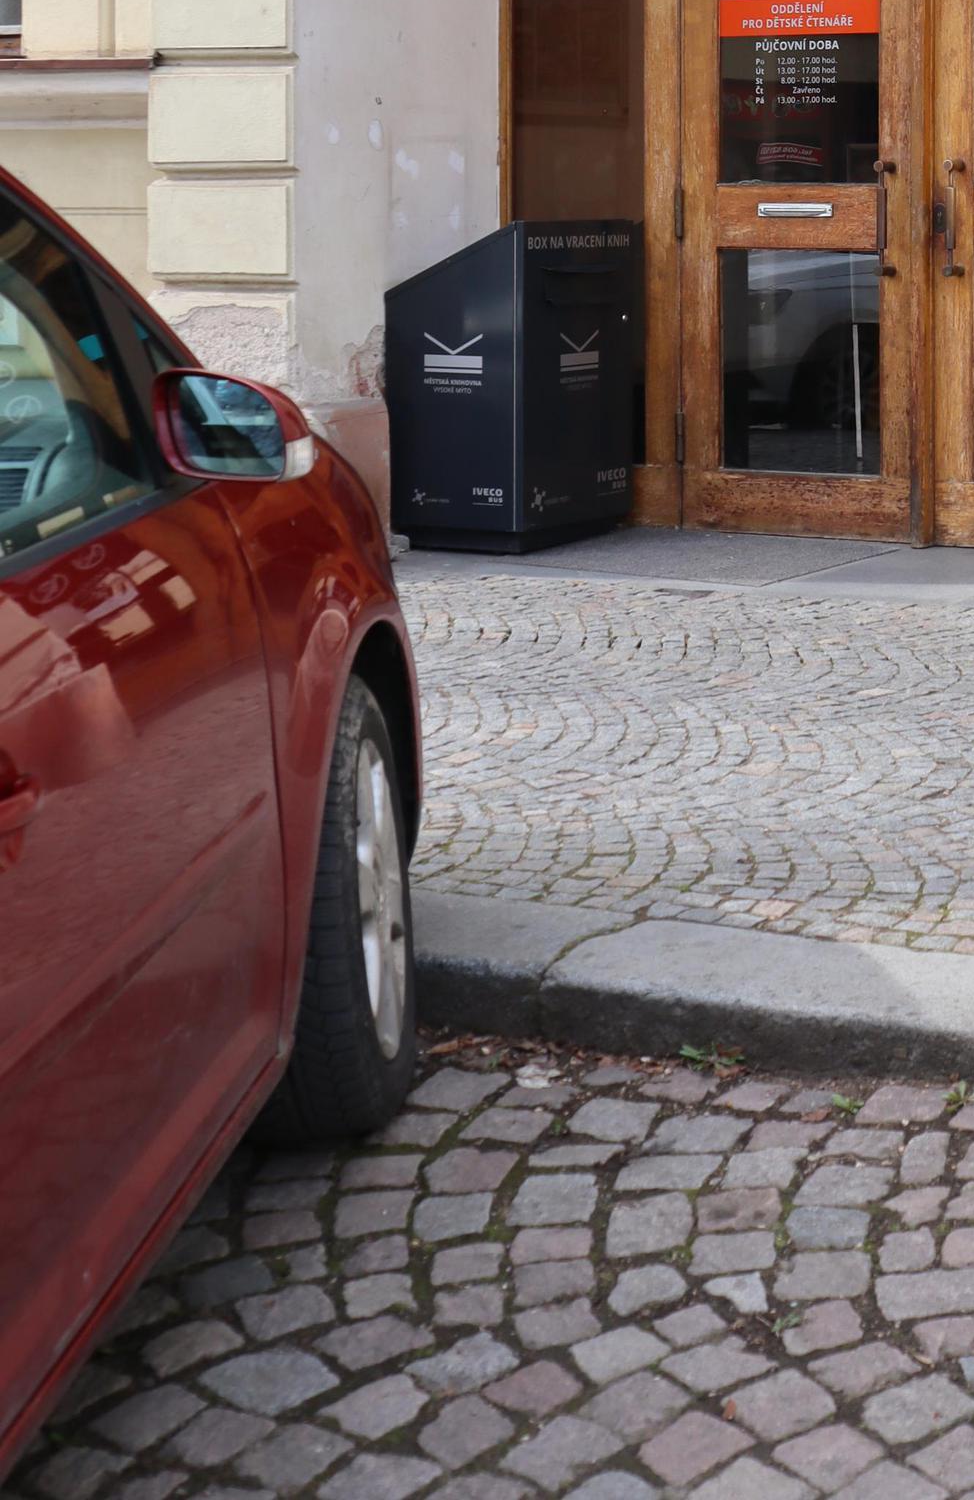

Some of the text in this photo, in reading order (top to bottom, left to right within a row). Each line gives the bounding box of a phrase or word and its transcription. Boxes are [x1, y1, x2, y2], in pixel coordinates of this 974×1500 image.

[770, 1, 824, 14] ODDĚLENÍ
[742, 15, 854, 28] PRO DĚTSKÉ ČTENÁŘE
[755, 38, 840, 53] PŮJČOVNÍ DOBA
[822, 56, 838, 64] hod.
[755, 67, 765, 75] Út
[822, 66, 838, 74] hod.
[822, 76, 838, 84] hod.
[755, 86, 821, 94] Čt Zavřeno
[755, 96, 765, 104] Pá
[777, 96, 796, 104] 13.00
[801, 96, 820, 104] 17.00
[822, 96, 838, 104] hod.
[527, 231, 630, 250] BOX NA VRACENÍ KNIH
[597, 467, 626, 483] IVECO
[472, 487, 503, 497] IVECO
